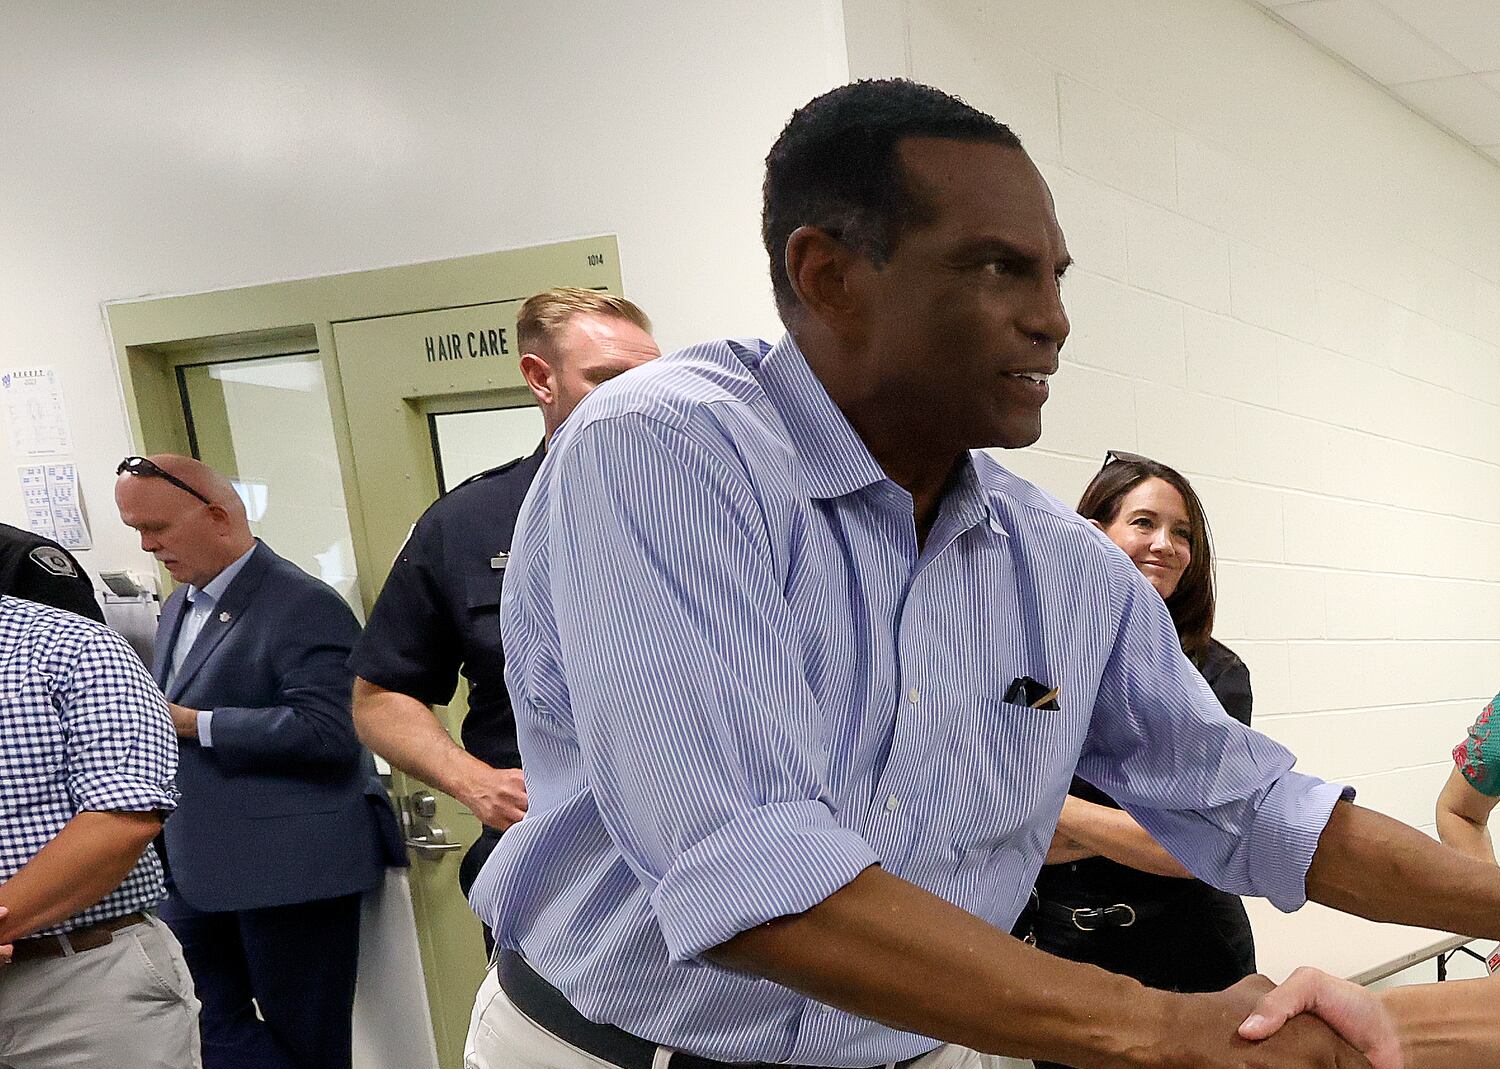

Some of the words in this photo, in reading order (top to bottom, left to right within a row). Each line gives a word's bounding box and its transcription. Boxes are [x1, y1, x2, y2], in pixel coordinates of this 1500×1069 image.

[588, 254, 604, 266] 1014
[425, 332, 463, 363] HAIR
[467, 328, 509, 358] CARE
